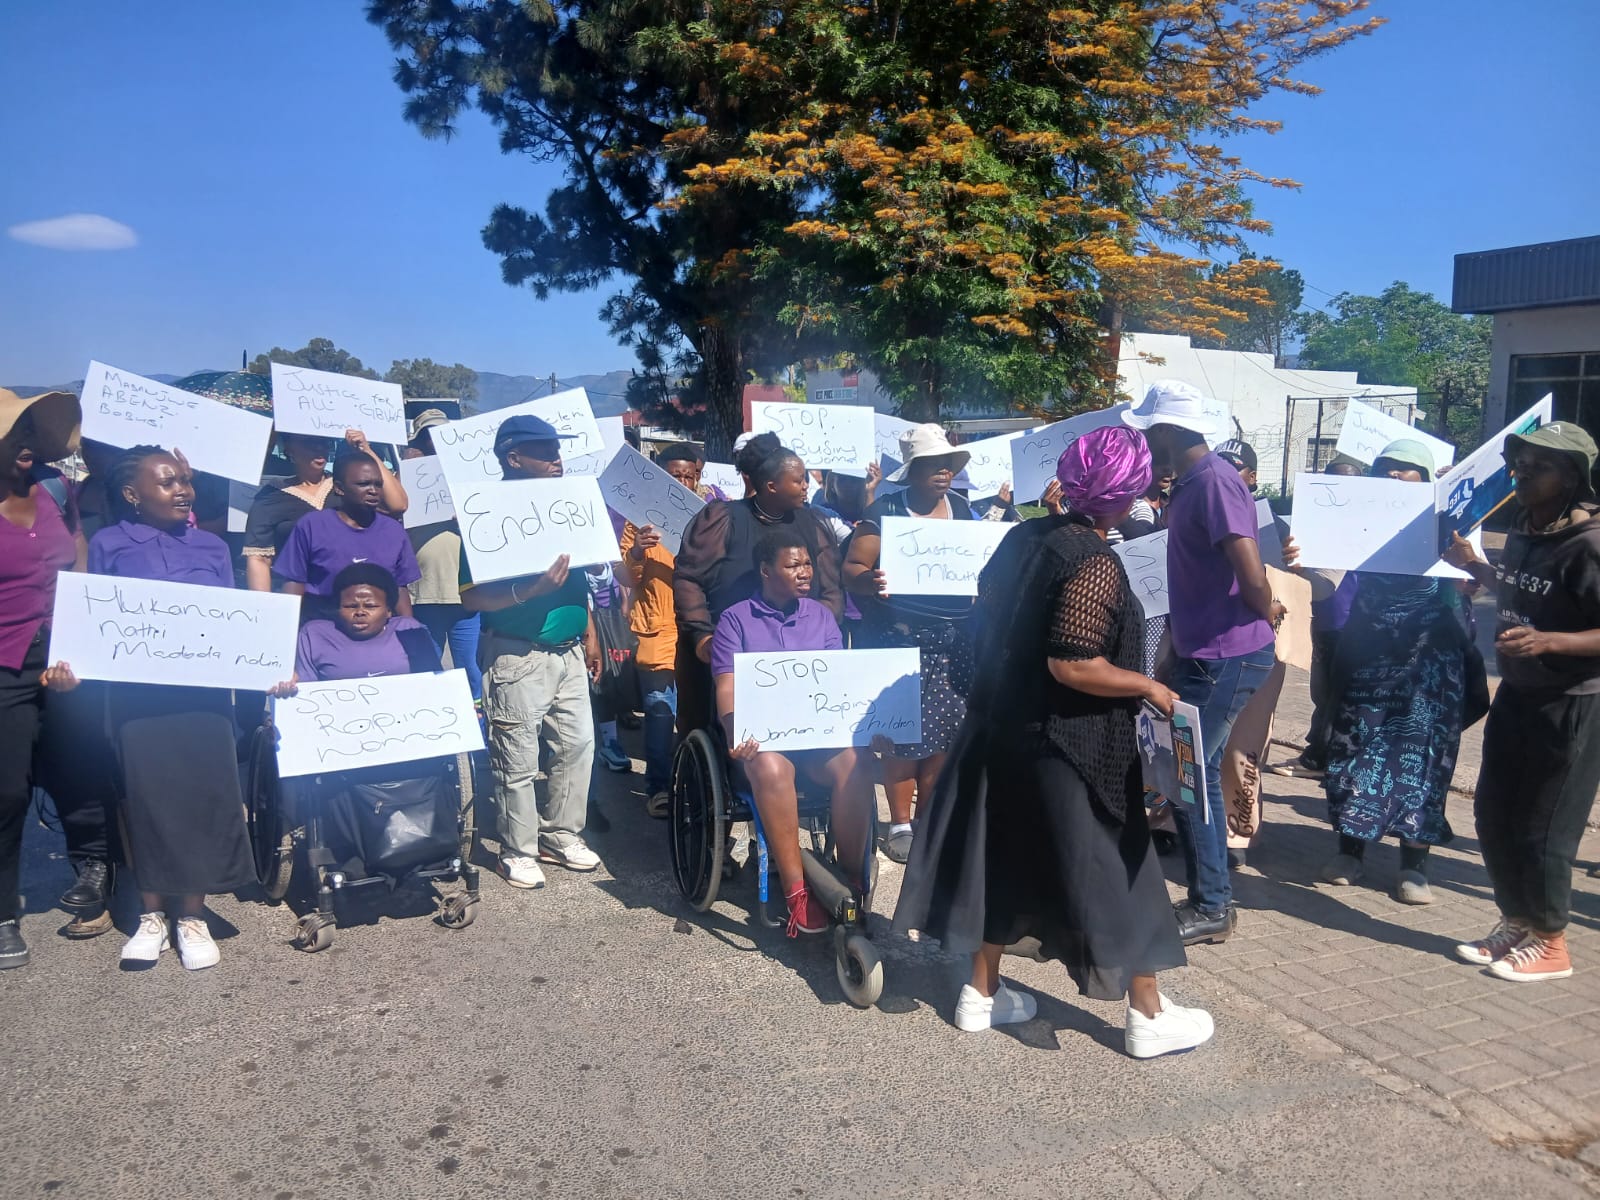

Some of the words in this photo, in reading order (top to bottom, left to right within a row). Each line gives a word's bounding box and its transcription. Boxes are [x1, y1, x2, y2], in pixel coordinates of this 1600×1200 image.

[463, 492, 544, 553] End
[549, 499, 595, 532] GBV
[896, 527, 977, 558] Justice
[755, 658, 828, 688] STOP
[296, 684, 380, 714] STOP
[1226, 751, 1258, 839] California
